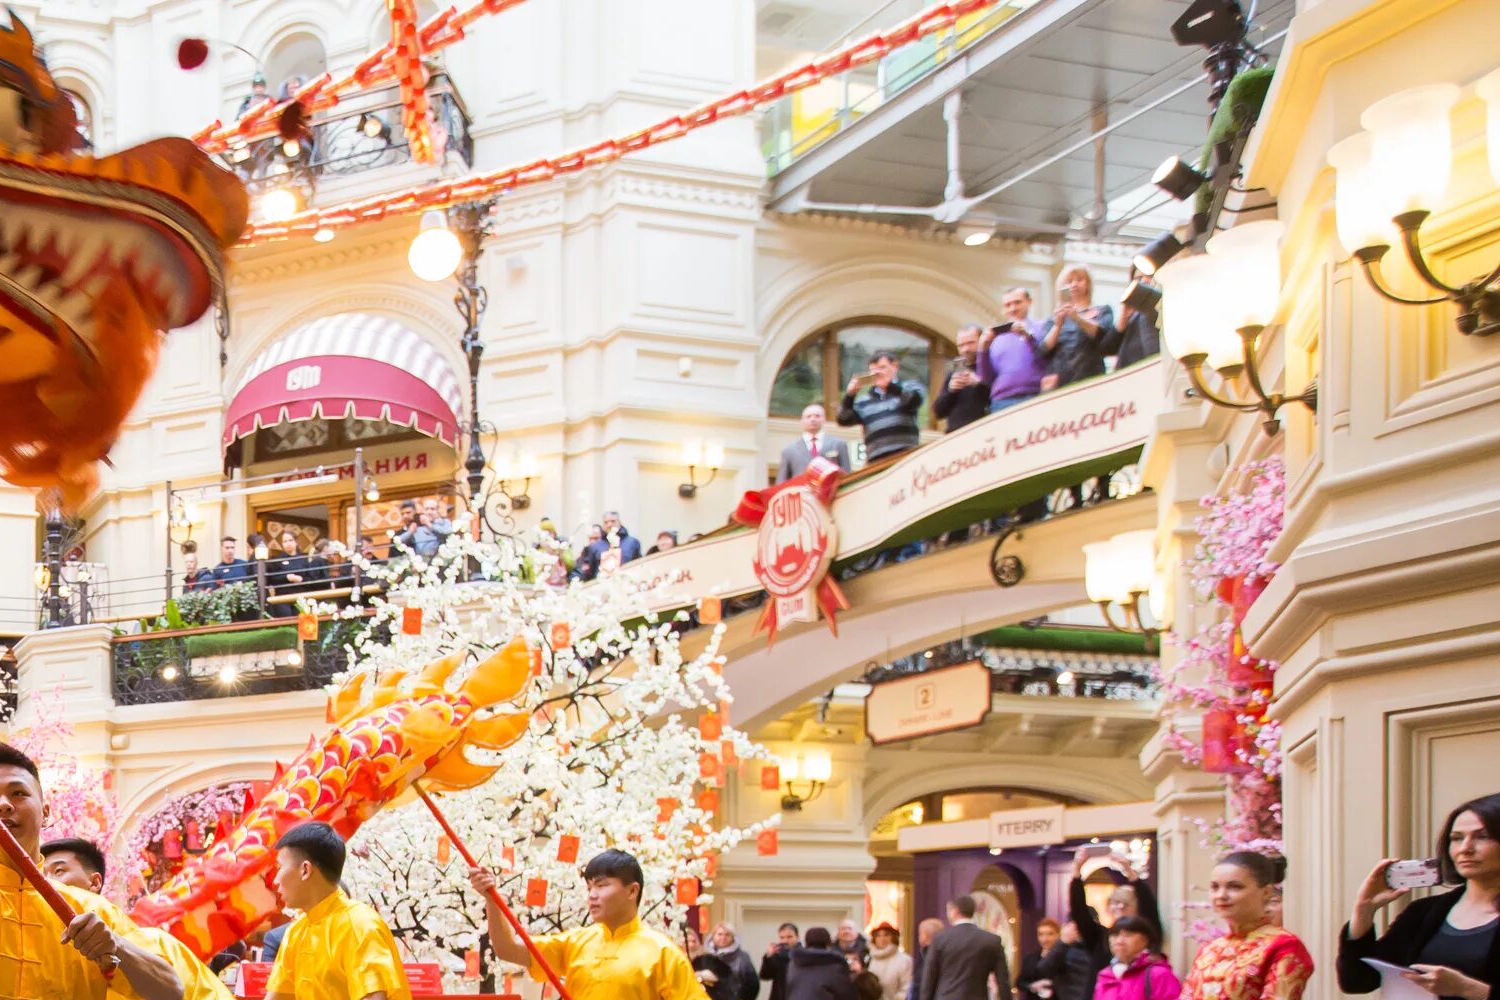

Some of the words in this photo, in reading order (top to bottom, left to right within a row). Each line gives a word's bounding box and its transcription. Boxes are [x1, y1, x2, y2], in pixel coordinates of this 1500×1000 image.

[911, 436, 997, 498] Красной
[1004, 399, 1137, 454] площади
[920, 688, 930, 705] 2
